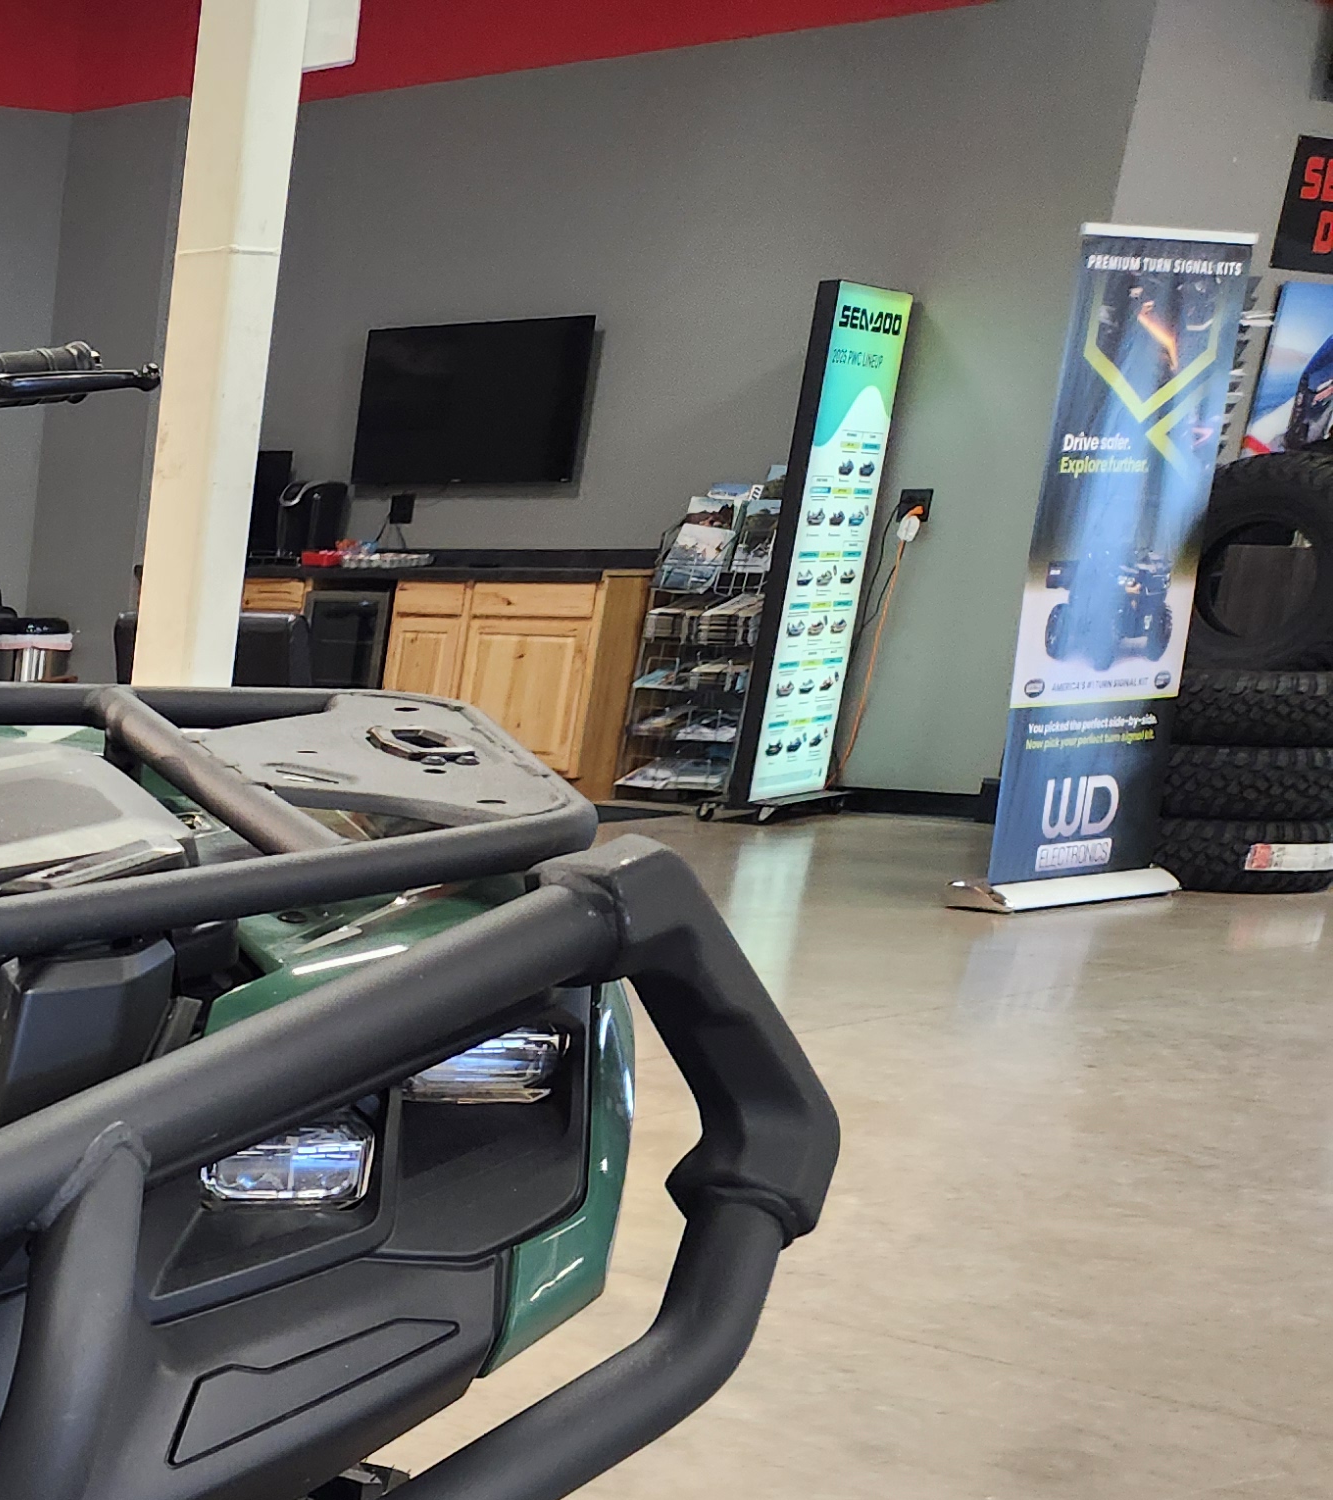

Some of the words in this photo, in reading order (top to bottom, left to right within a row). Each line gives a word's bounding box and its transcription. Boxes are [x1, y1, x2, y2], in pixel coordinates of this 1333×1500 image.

[1087, 254, 1141, 271] PREMIUM
[1142, 257, 1172, 273] TURN
[1173, 259, 1214, 275] SIGNAL
[1215, 261, 1242, 276] KITS
[1062, 432, 1099, 451] Drive
[1100, 433, 1131, 450] safer.
[1060, 456, 1108, 478] Explore
[1108, 456, 1149, 473] further.
[1028, 722, 1043, 734] You
[1042, 775, 1119, 839] WD
[1039, 841, 1109, 868] ELECTRONICS
